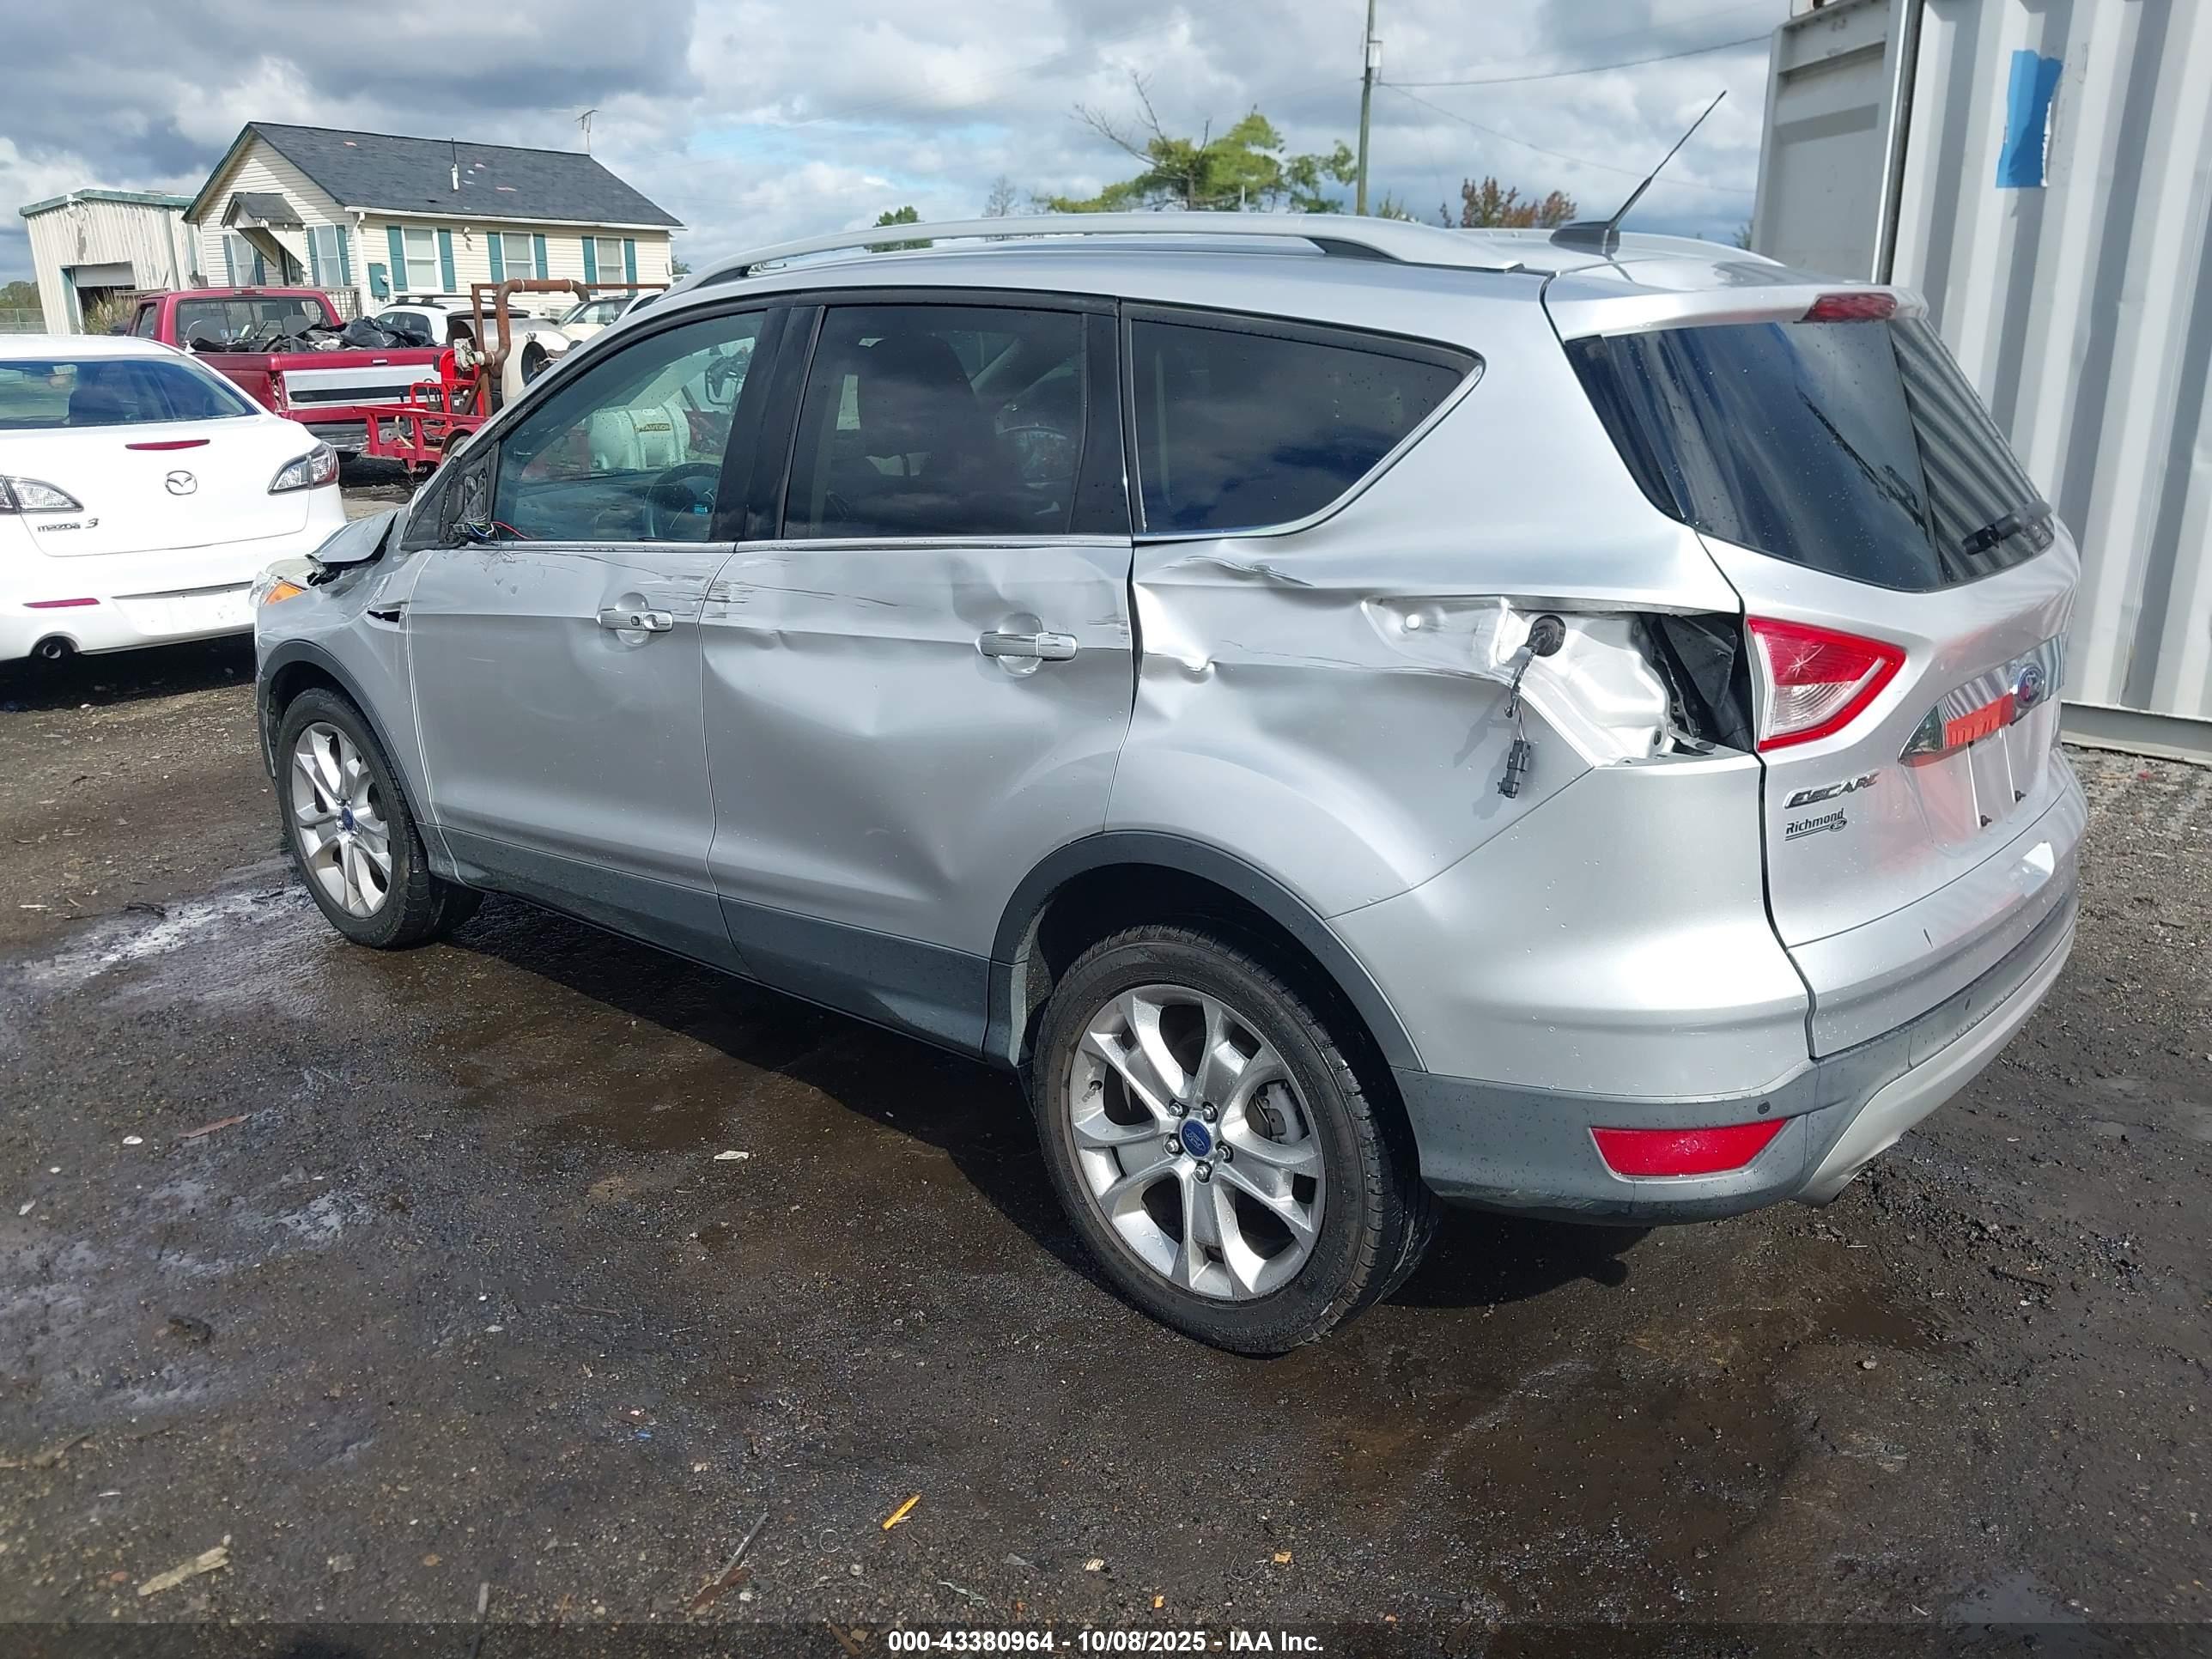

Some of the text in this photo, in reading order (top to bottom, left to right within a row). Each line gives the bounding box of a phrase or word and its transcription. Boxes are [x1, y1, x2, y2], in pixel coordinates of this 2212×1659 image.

[37, 518, 99, 532] mazda 3
[1783, 769, 1880, 809] ESCAPE
[1786, 807, 1844, 835] Richmond
